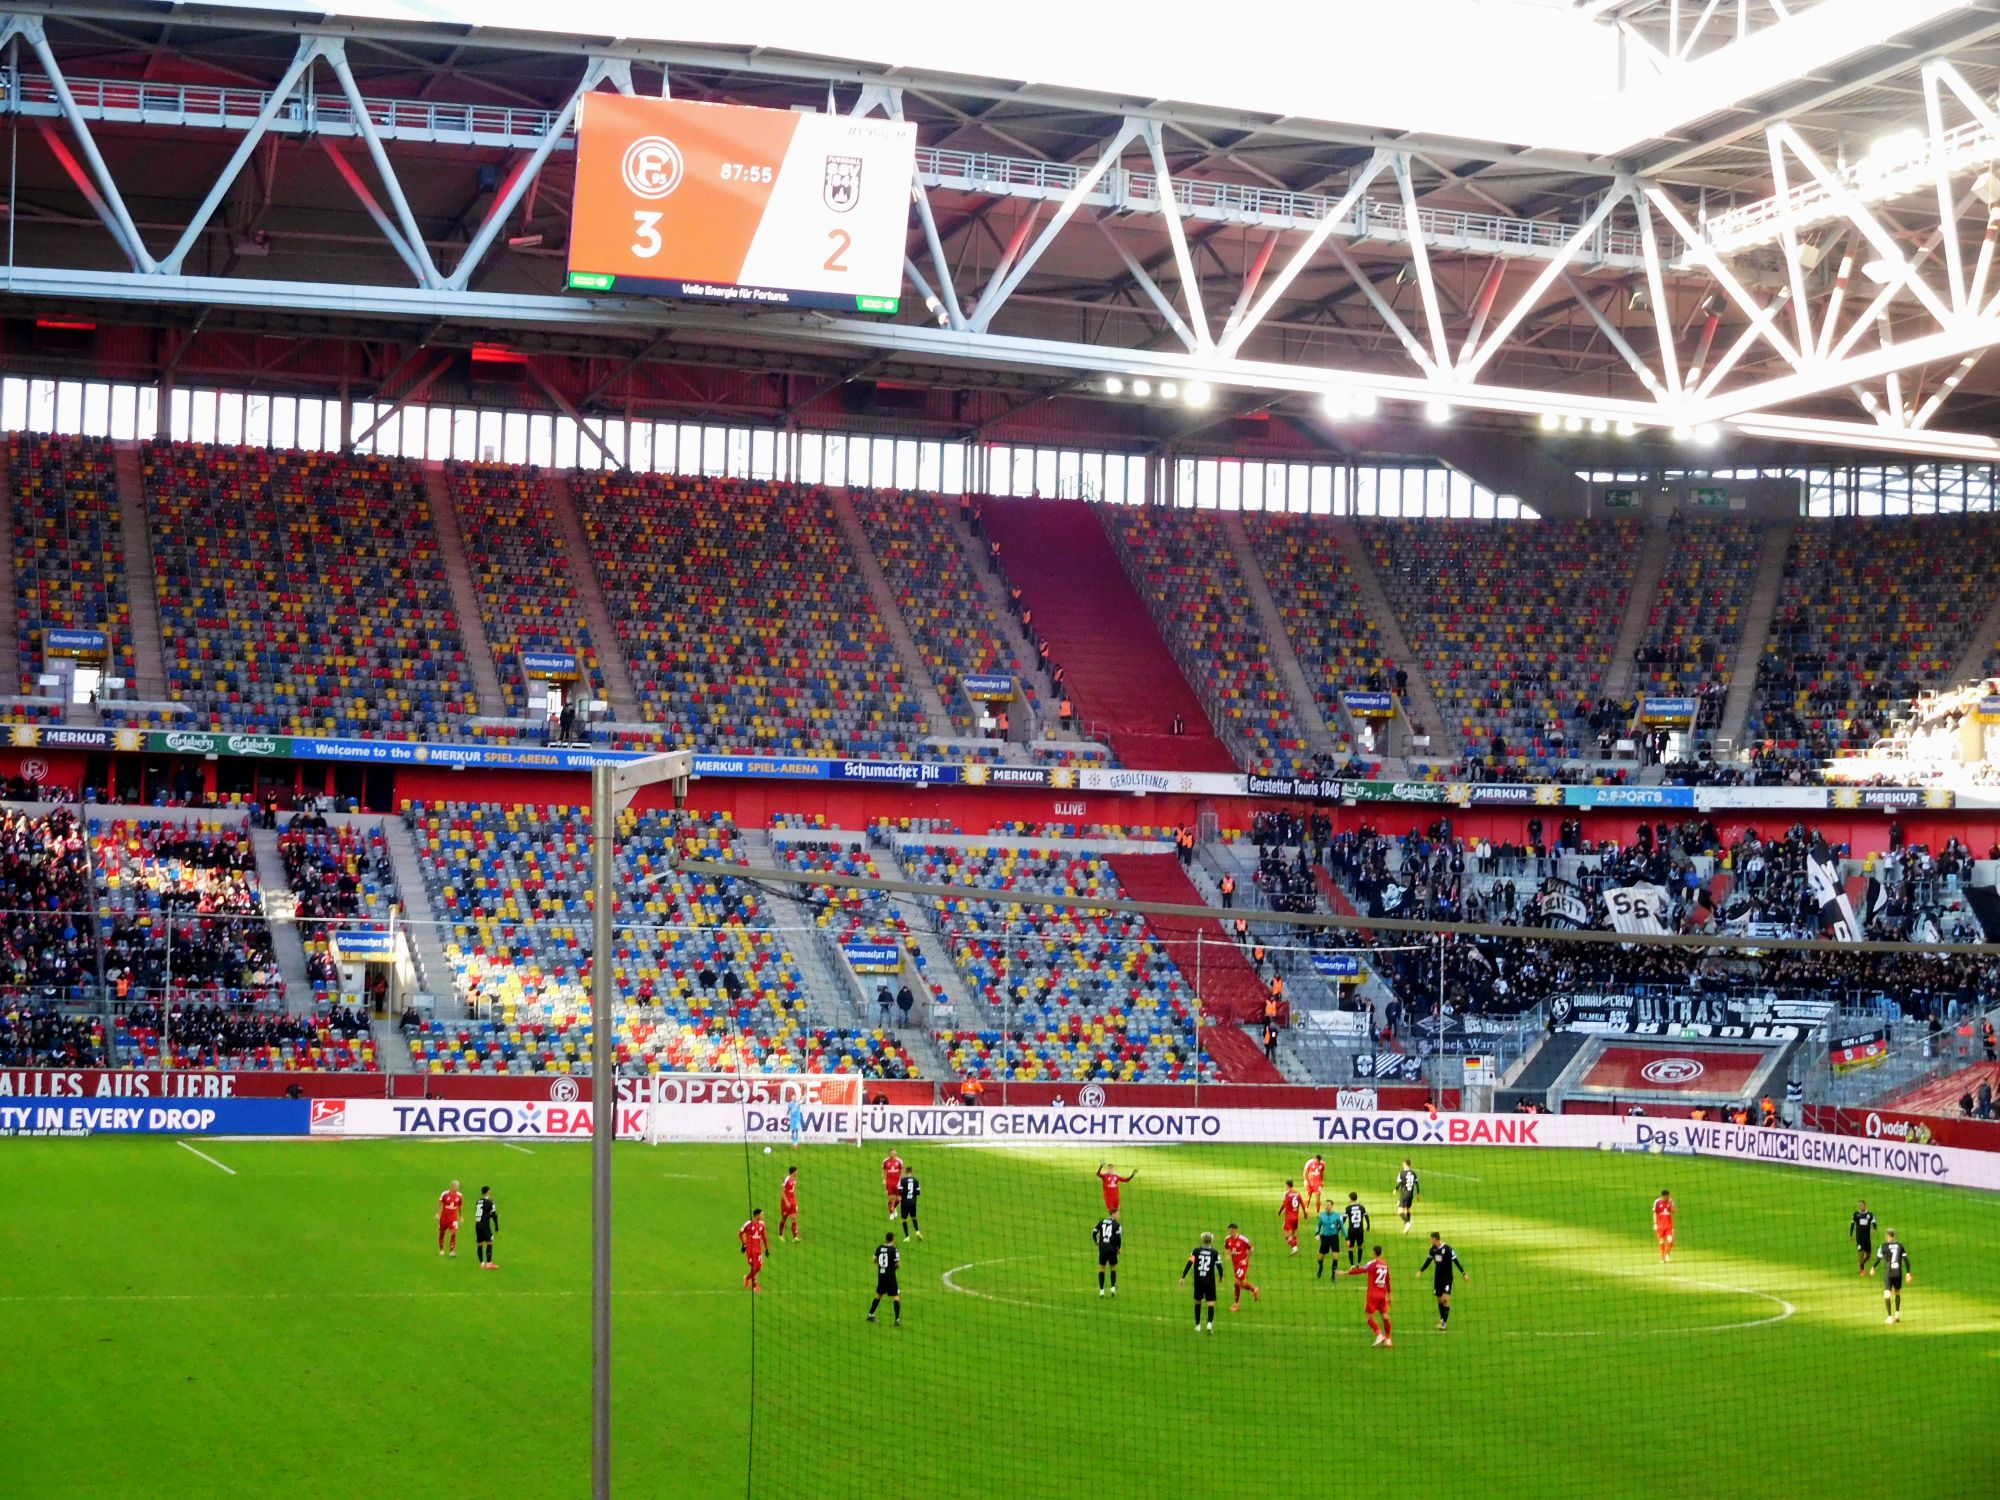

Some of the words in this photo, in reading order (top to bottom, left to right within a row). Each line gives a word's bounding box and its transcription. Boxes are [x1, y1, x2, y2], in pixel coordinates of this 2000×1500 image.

[720, 163, 772, 183] 87:55
[631, 211, 664, 258] 3
[823, 228, 851, 272] 2
[682, 283, 704, 295] Volle
[705, 285, 738, 299] Energie
[739, 287, 752, 298] für
[753, 289, 790, 302] Fortuna.
[47, 731, 106, 744] MERKUR
[166, 733, 214, 750] Carlsberg
[228, 736, 276, 753] Carlsberg
[315, 743, 370, 757] Welcome
[373, 747, 387, 757] to
[391, 748, 411, 759] the
[431, 750, 481, 761] MERKUR
[484, 752, 559, 765] SPIEL-ARENA
[695, 760, 743, 773] MERKUR
[747, 762, 819, 775] SPIEL-ARENA
[844, 763, 918, 781] Schumacher
[921, 765, 940, 780] Alt
[993, 769, 1044, 782] MERKUR
[1109, 776, 1169, 791] GEROLSTEINER
[1249, 775, 1293, 795] Gerstetter
[1294, 780, 1319, 796] Touris
[1320, 780, 1340, 798] 1846
[1475, 788, 1528, 799] MERKUR
[1597, 789, 1663, 803] D.SPORTS
[1865, 792, 1918, 804] MERKUR
[1055, 803, 1084, 816] D.LIVE
[1610, 995, 1634, 1008] CREW
[1433, 1038, 1463, 1050] Back
[0, 1072, 84, 1097] ALLES
[96, 1073, 150, 1097] AUS
[162, 1075, 237, 1098] LIEBE
[1340, 1095, 1374, 1111] YAYLA
[1, 1107, 32, 1128] TY
[37, 1107, 64, 1128] IN
[70, 1108, 144, 1129] EVERY
[150, 1109, 216, 1130] DROP
[333, 1113, 344, 1126] 2
[393, 1106, 514, 1133] TARGO
[546, 1107, 647, 1134] BAK
[747, 1110, 791, 1133] Das
[799, 1111, 848, 1133] WIE
[855, 1106, 904, 1133] FÜR
[909, 1112, 983, 1136] MICH
[990, 1112, 1124, 1136] GEMACHT
[1129, 1114, 1221, 1136] KONTO
[1313, 1116, 1419, 1141] TARGO
[1449, 1118, 1539, 1143] BANK
[1636, 1123, 1679, 1147] Das
[1684, 1126, 1721, 1149] WIE
[1725, 1126, 1757, 1153] FÜR
[1759, 1132, 1799, 1160] MICH
[1802, 1138, 1882, 1168] GEMACHT
[1884, 1149, 1944, 1176] KONTO
[908, 1181, 914, 1195] 9
[1292, 1195, 1298, 1208] 6
[1101, 1223, 1113, 1239] 14
[1197, 1255, 1212, 1272] 32
[1890, 1248, 1898, 1264] 7
